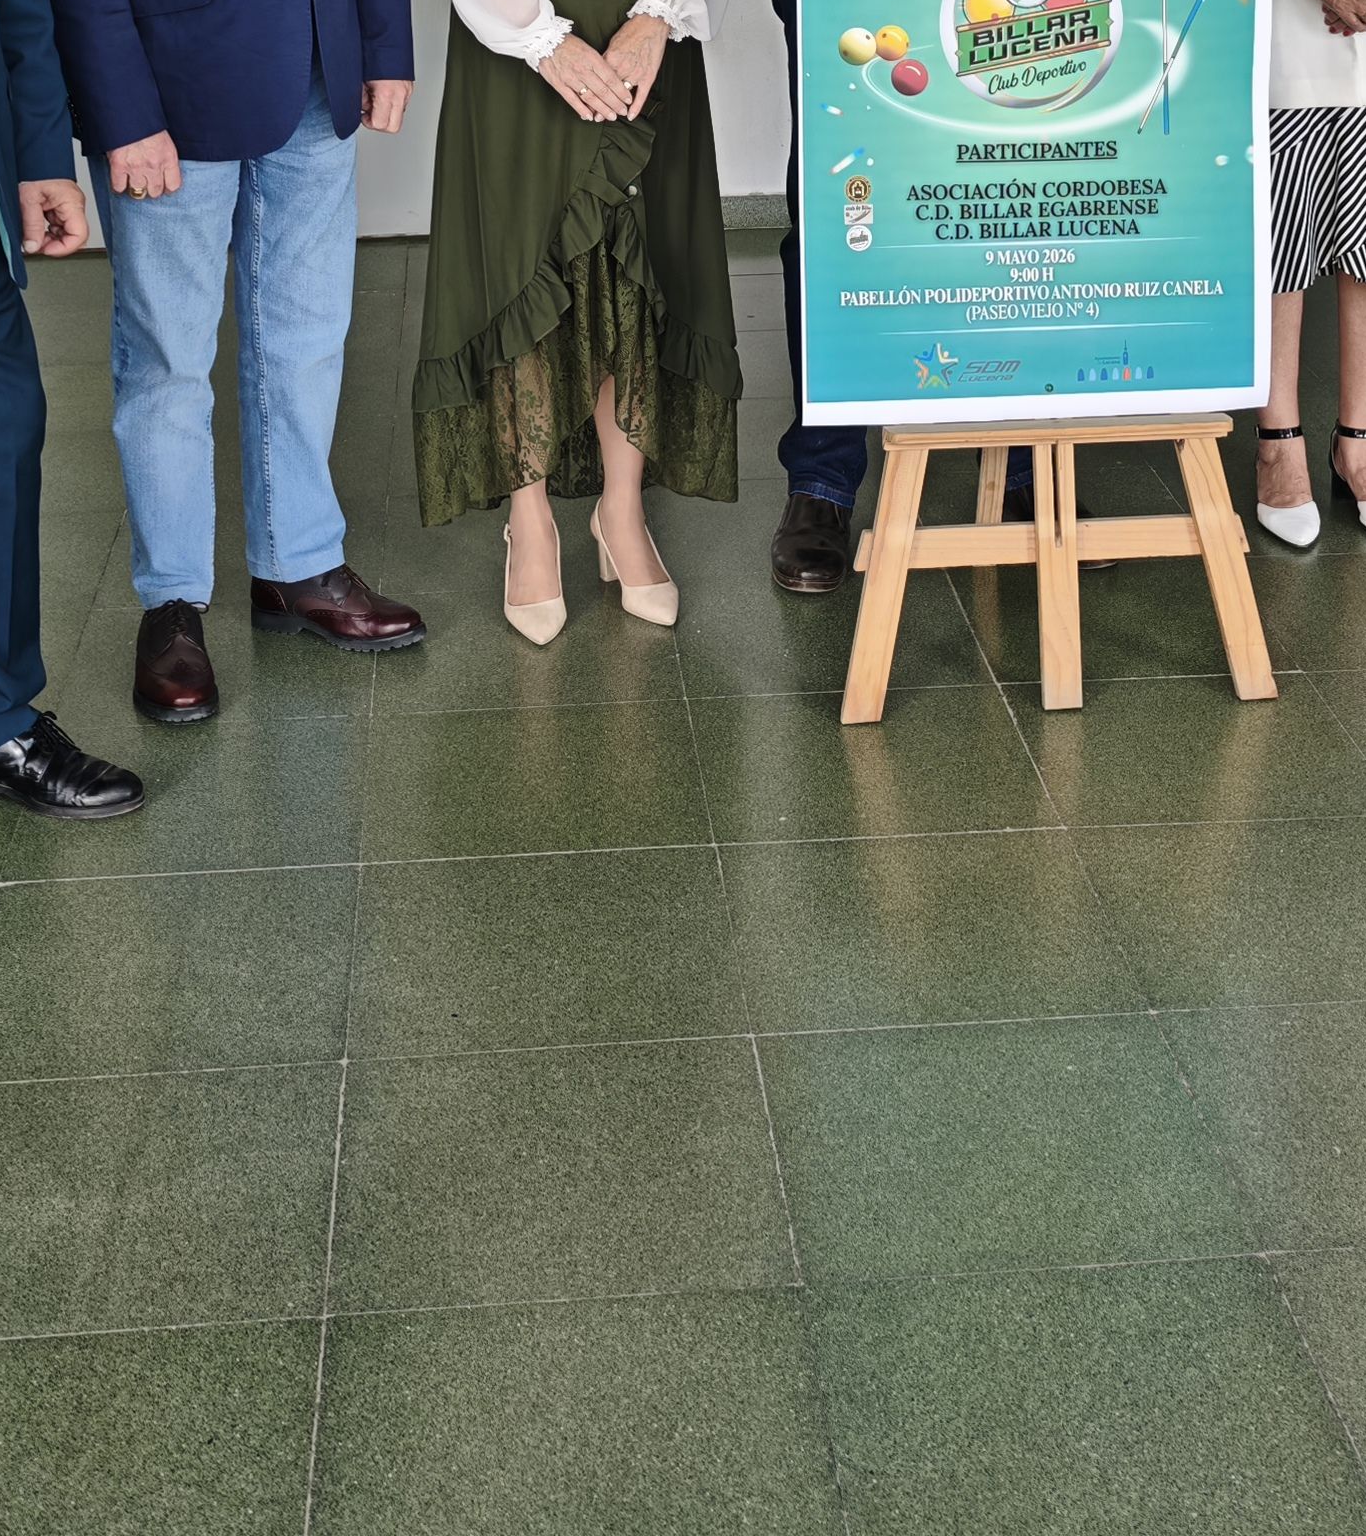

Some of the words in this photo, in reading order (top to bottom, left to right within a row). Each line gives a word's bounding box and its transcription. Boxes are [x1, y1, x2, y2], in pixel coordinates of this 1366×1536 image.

[973, 9, 1092, 47] BILLAR
[969, 25, 1099, 66] LUCENA
[988, 73, 1019, 95] Club
[1021, 59, 1087, 87] Deportivo
[956, 140, 1118, 161] PARTICIPANTES
[906, 179, 1037, 201] ASOCIACIÓN
[1042, 178, 1168, 198] CORDOBESA
[915, 204, 954, 221] C.D.
[959, 202, 1033, 220] BILLAR
[1038, 198, 1159, 218] EGABRENSE
[935, 223, 974, 240] C.D.
[979, 221, 1052, 240] BILLAR
[1057, 218, 1141, 237] LUCENA
[985, 250, 995, 265] 9
[997, 249, 1040, 265] MAYO
[1042, 248, 1076, 264] 2026
[1009, 267, 1039, 283] 9:00
[1042, 267, 1055, 282] H
[840, 286, 921, 307] PABELLÓN
[924, 285, 1048, 305] POLIDEPORTIVO
[1051, 282, 1121, 300] ANTONIO
[1124, 281, 1161, 298] RUIZ
[1162, 280, 1224, 297] CANELA
[966, 304, 1019, 323] (PASEO
[1020, 303, 1063, 320] VIEJO
[1085, 302, 1100, 320] 4)
